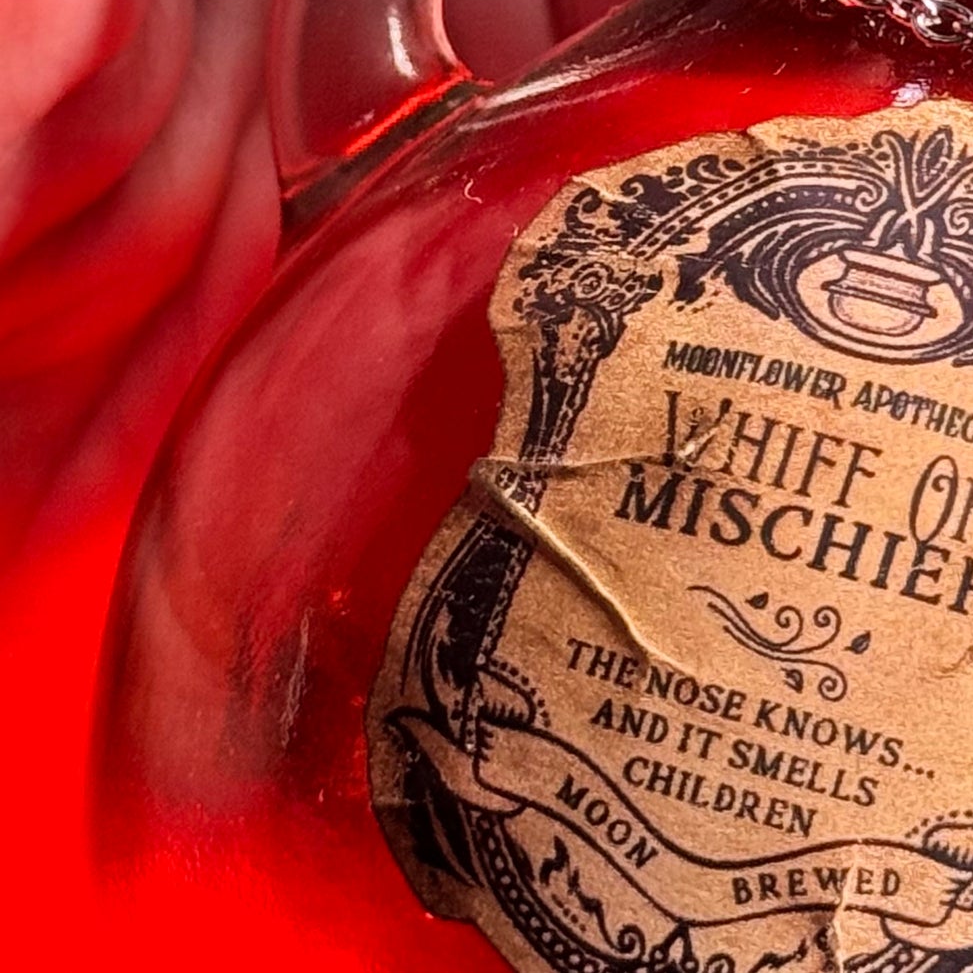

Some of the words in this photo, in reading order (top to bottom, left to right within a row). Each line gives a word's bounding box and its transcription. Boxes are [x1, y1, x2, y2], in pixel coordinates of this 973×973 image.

[664, 341, 846, 409] MOONFLOWER
[664, 389, 883, 508] WHIFF
[566, 638, 636, 688] THE
[644, 665, 746, 722] NOSE
[754, 697, 935, 780] KNOWS...
[590, 698, 676, 744] AND
[678, 724, 724, 759] IT
[728, 739, 879, 807] SMELLS
[555, 774, 659, 870] MOON
[732, 867, 900, 905] BREWED
[622, 755, 818, 837] CHILDREN
